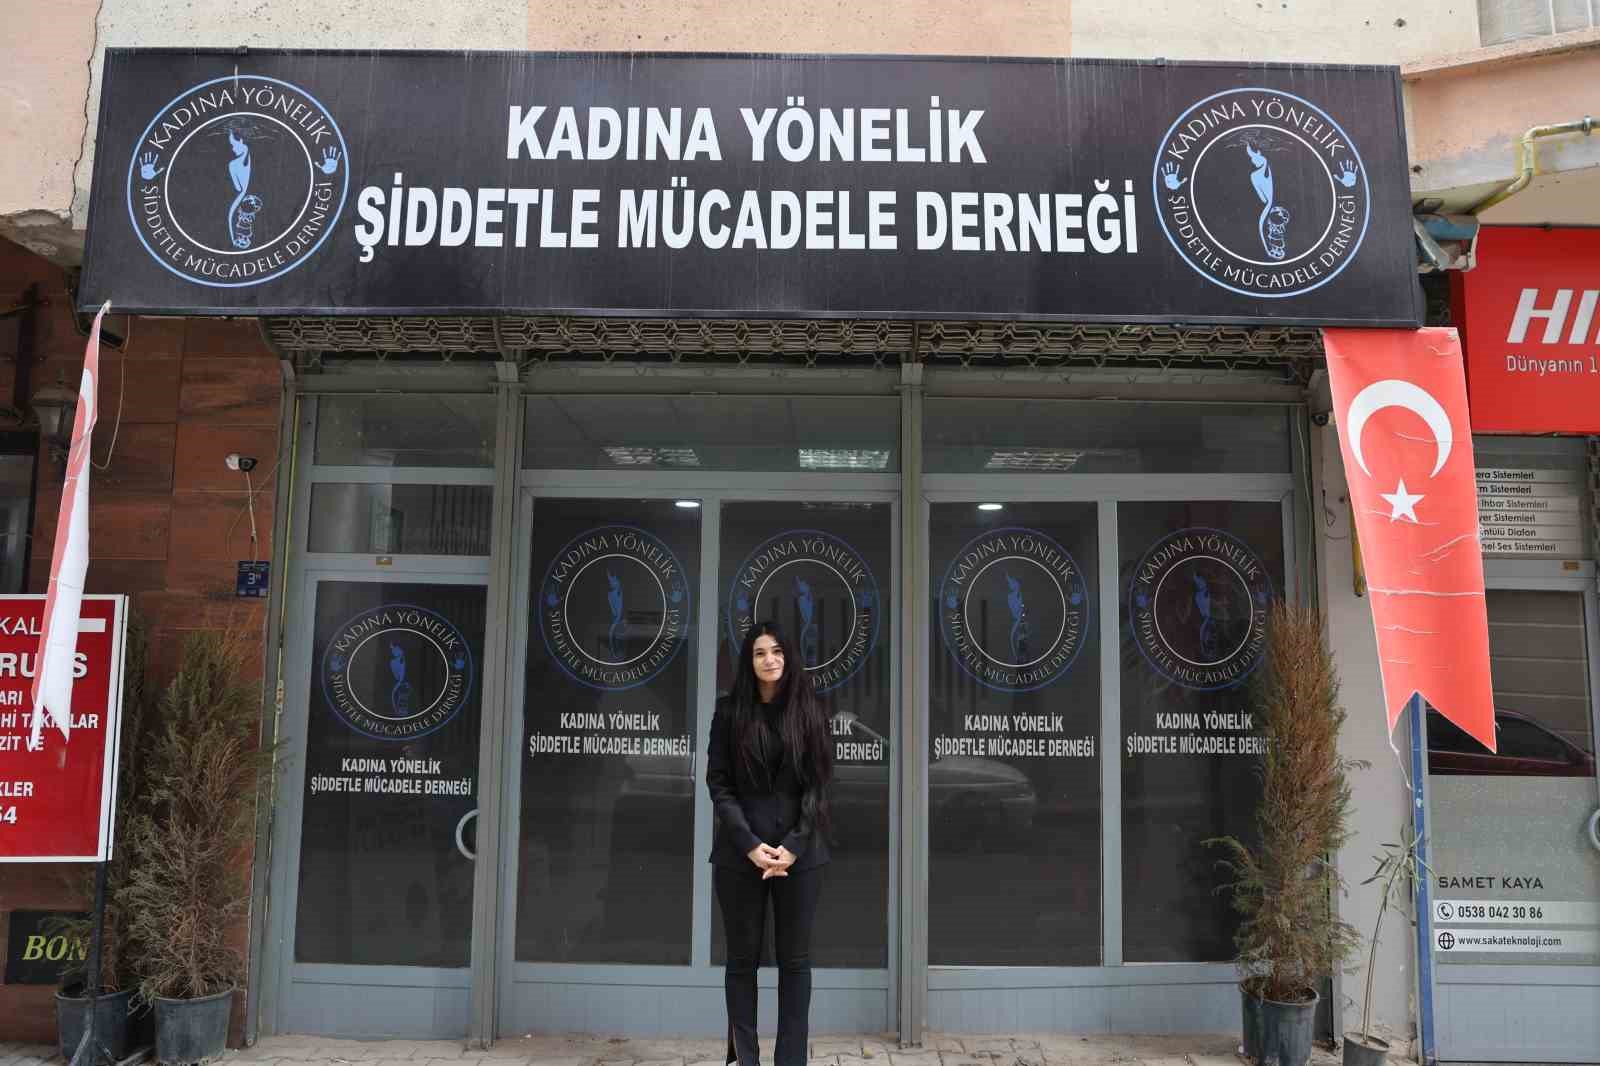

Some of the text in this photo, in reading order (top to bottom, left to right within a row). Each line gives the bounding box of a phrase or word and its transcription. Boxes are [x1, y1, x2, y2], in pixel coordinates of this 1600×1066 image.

[148, 84, 332, 151] KADINA YÖNELİK
[506, 95, 989, 164] KADINA YÖNELİK
[1167, 96, 1345, 161] KADINA YÖNELİK
[143, 180, 334, 279] ŞİDDETLE MÜCADELE DERNEĞİ
[354, 171, 1139, 263] ŞİDDETLE MÜCADELE DERNEĞİ
[1167, 193, 1358, 289] ŞİDDETLE MÜCADELE DERNEĞİ
[1506, 287, 1600, 345] HI
[1506, 355, 1583, 377] Dünyanın
[551, 536, 609, 584] KADINA
[740, 539, 798, 589] KADINA
[951, 536, 1008, 585] KADINA
[1138, 536, 1195, 585] KADINA
[334, 613, 393, 652] KADINA
[0, 652, 88, 679] RUS
[21, 713, 99, 729] TKILAR
[560, 709, 660, 731] KADINA YÖNELİK
[964, 711, 1064, 733] KADINA YÖNELİK
[1156, 710, 1254, 730] KADINA YÖNELİK
[529, 731, 691, 758] ŞİDDETLE MÜCADELE DERNEĞİ
[836, 737, 883, 761] DERNEĞİ
[934, 733, 1095, 760] ŞİDDETLE MÜCADELE DERNEĞİ
[1127, 731, 1178, 758] ŞİDDETLE
[1179, 732, 1236, 755] MÜCADELE
[341, 756, 441, 775] KADINA YÖNELİK
[310, 773, 472, 796] ŞİDDETLE MÜCADELE DERNEĞİ
[1438, 876, 1544, 889] SAMET KAYA
[1458, 906, 1543, 919] 0538 042 30 86
[1458, 936, 1562, 948] www.sakateknoloji.com
